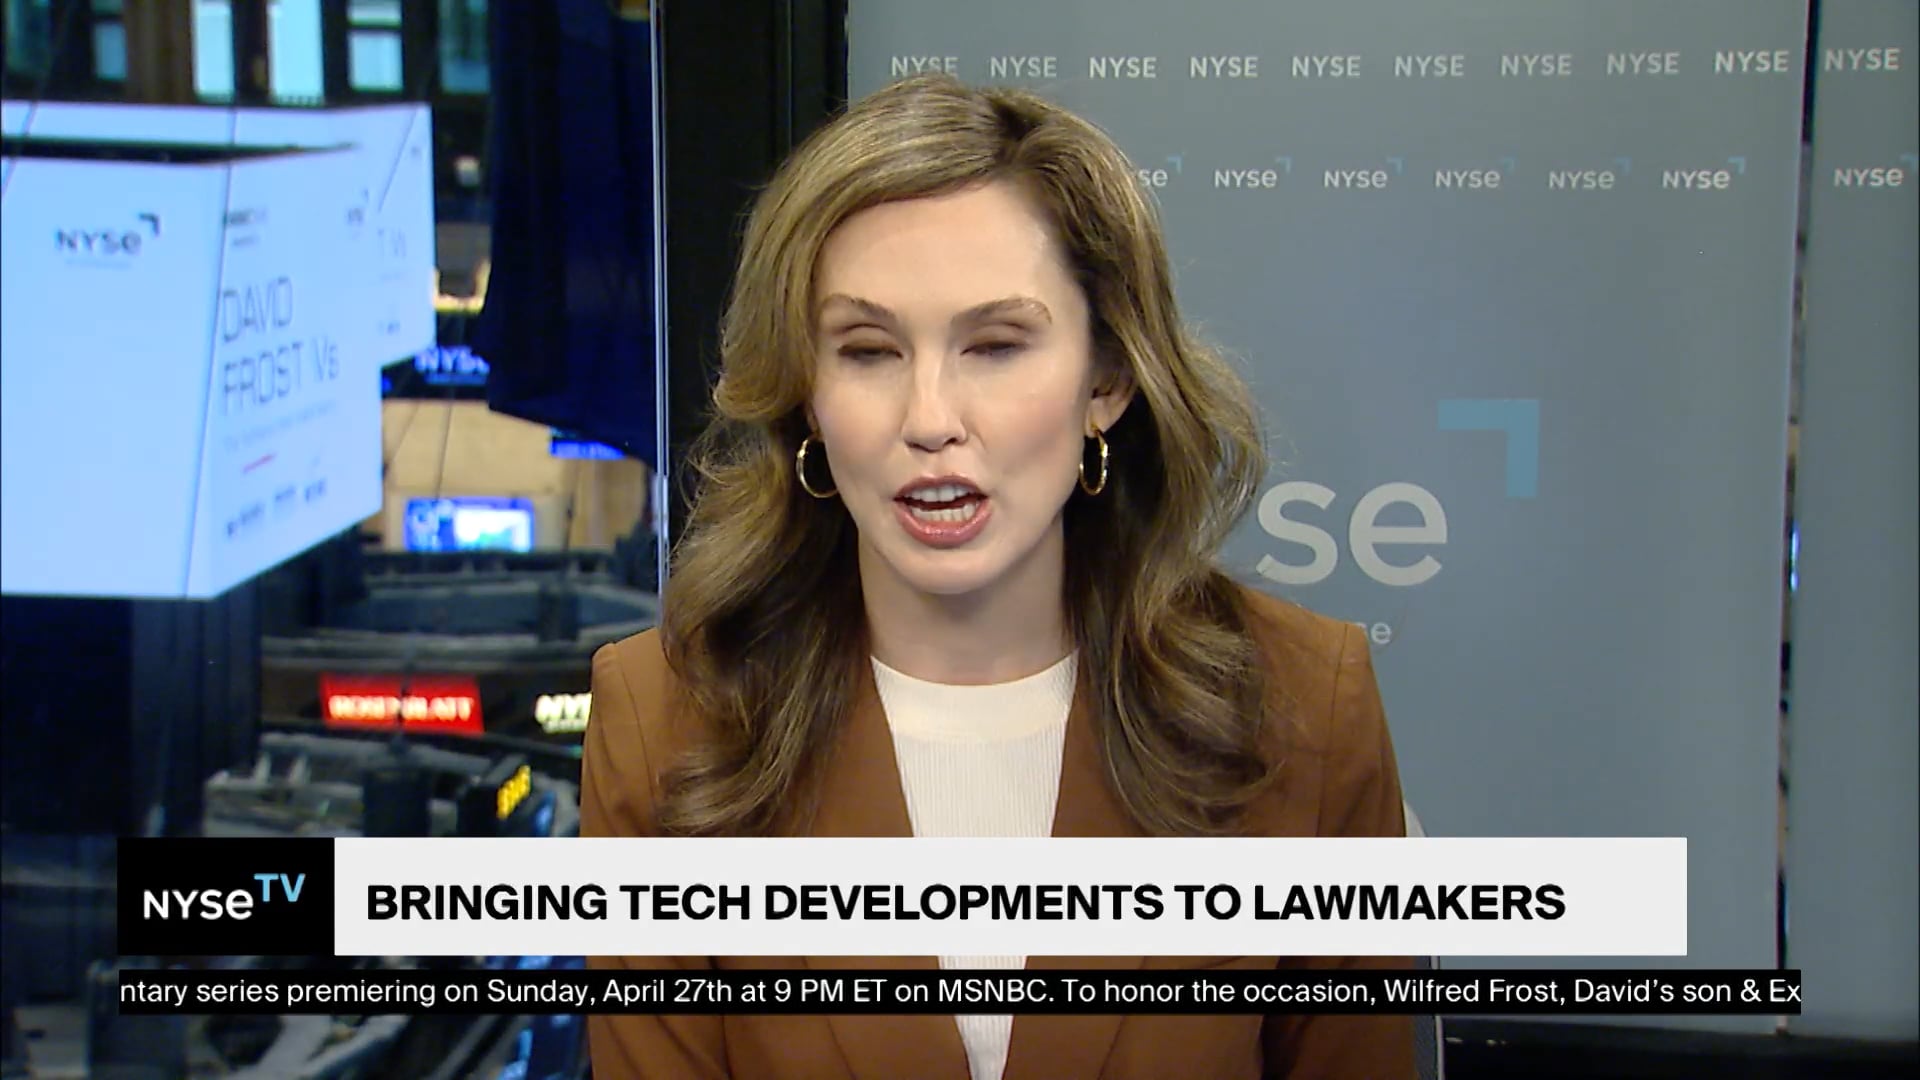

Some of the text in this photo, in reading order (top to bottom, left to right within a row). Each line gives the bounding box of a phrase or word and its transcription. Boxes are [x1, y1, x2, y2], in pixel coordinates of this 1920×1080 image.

[891, 51, 1788, 78] NYSE NYSE NYSE NYSE NYSE NYSE NYSE NYSE NYSE
[1824, 48, 1900, 71] NYSE
[223, 341, 303, 416] FROST
